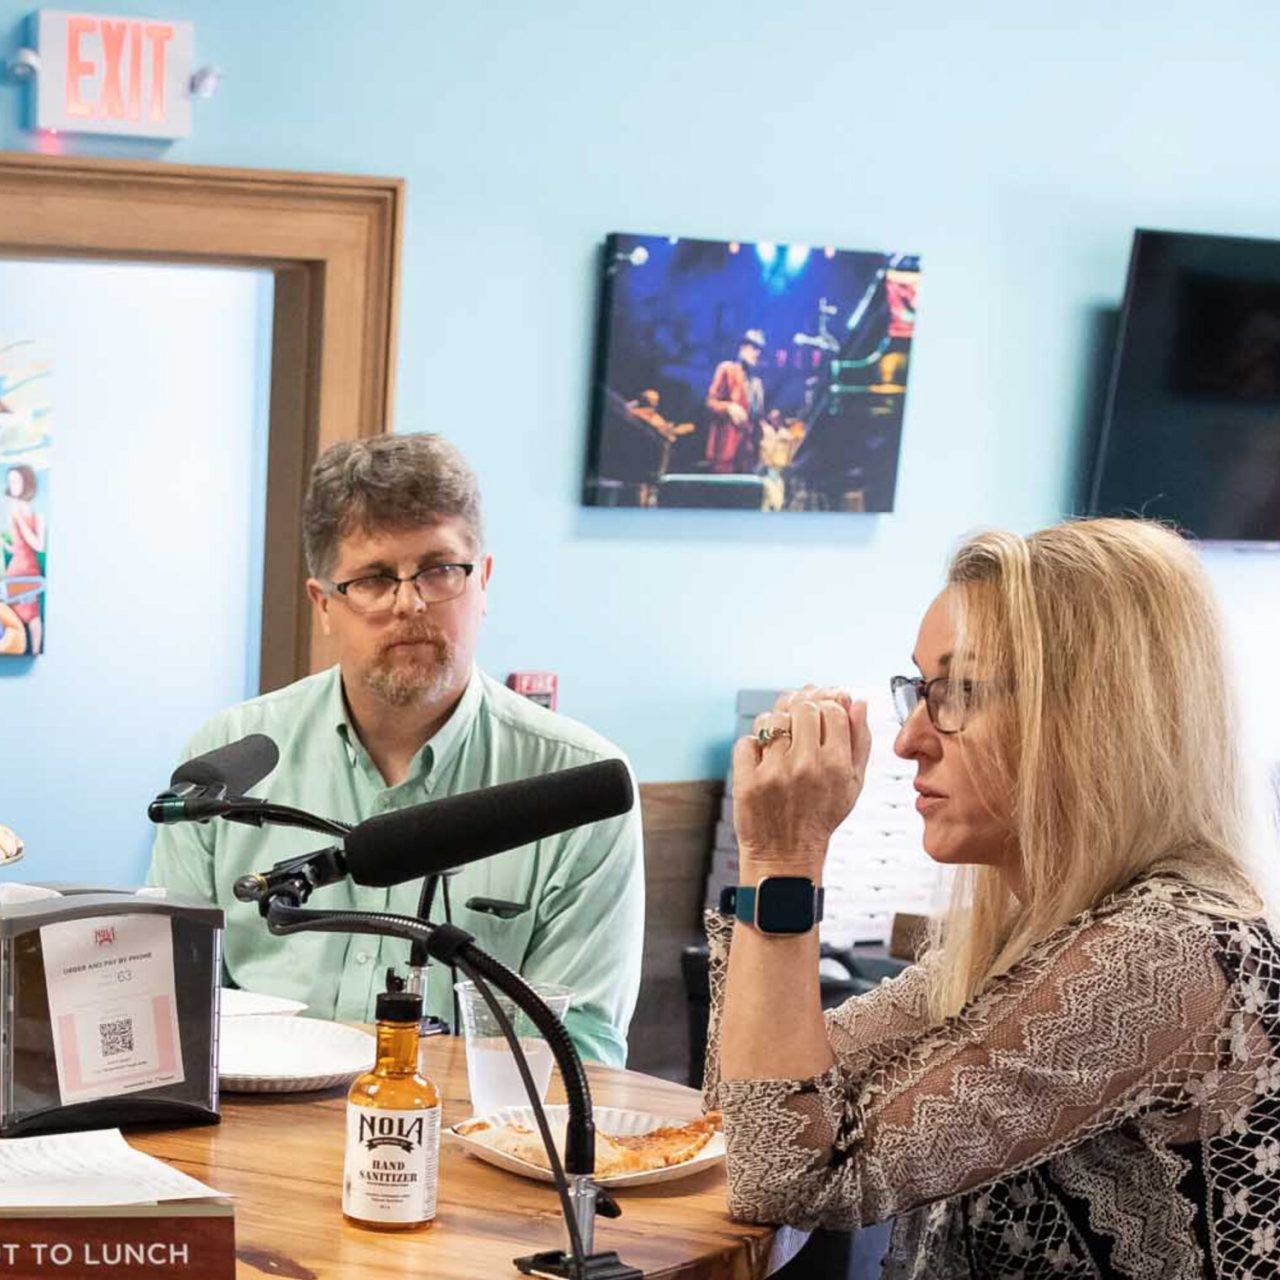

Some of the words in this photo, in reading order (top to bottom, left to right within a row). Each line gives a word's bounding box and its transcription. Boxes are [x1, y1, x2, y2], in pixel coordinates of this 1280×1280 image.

[66, 16, 174, 123] EXIT
[63, 963, 86, 975] ORDER
[88, 961, 102, 970] AND
[104, 959, 117, 967] PAY
[118, 956, 127, 964] BY
[128, 952, 152, 962] PHONE
[359, 1113, 424, 1147] NOLA
[359, 1170, 418, 1183] SANITIZER
[372, 1160, 405, 1171] HAND
[31, 1243, 73, 1266] TO
[84, 1243, 189, 1266] LUNCH
